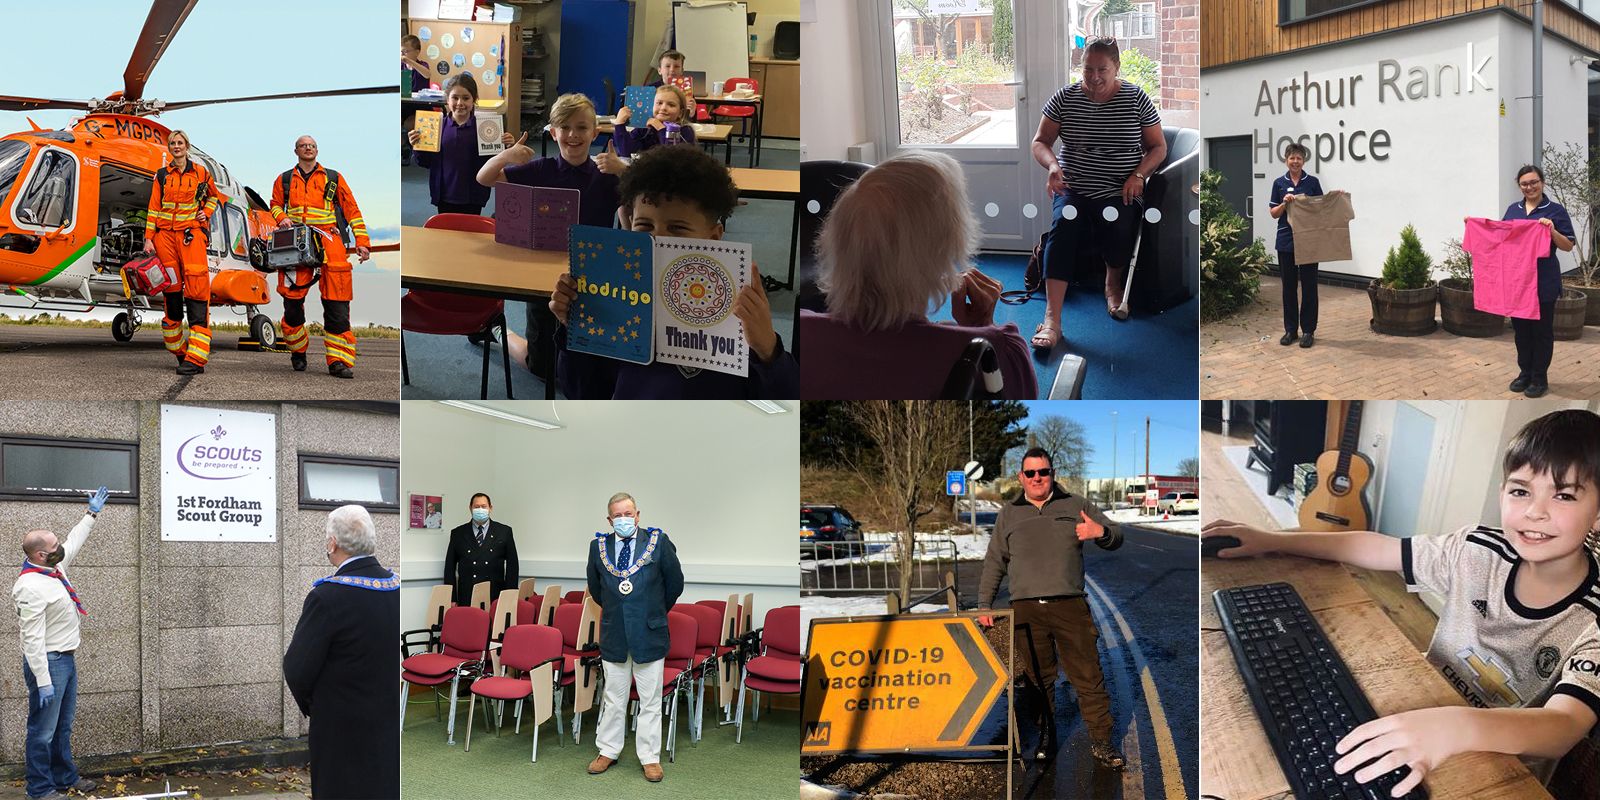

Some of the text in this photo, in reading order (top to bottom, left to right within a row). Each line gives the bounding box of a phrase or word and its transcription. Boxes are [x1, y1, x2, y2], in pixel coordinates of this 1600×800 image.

[1254, 42, 1494, 117] Arthur Rank
[84, 117, 163, 144] G-MGPS
[577, 278, 651, 306] Rodrigo
[666, 326, 708, 351] Thank
[711, 333, 735, 357] you
[194, 445, 262, 462] scouts
[204, 461, 239, 469] prepared
[177, 496, 262, 510] 1st Fordham
[177, 509, 262, 527] Scout Group
[830, 647, 944, 667] COVID-19
[818, 670, 951, 690] vaccination
[844, 693, 920, 712] centre
